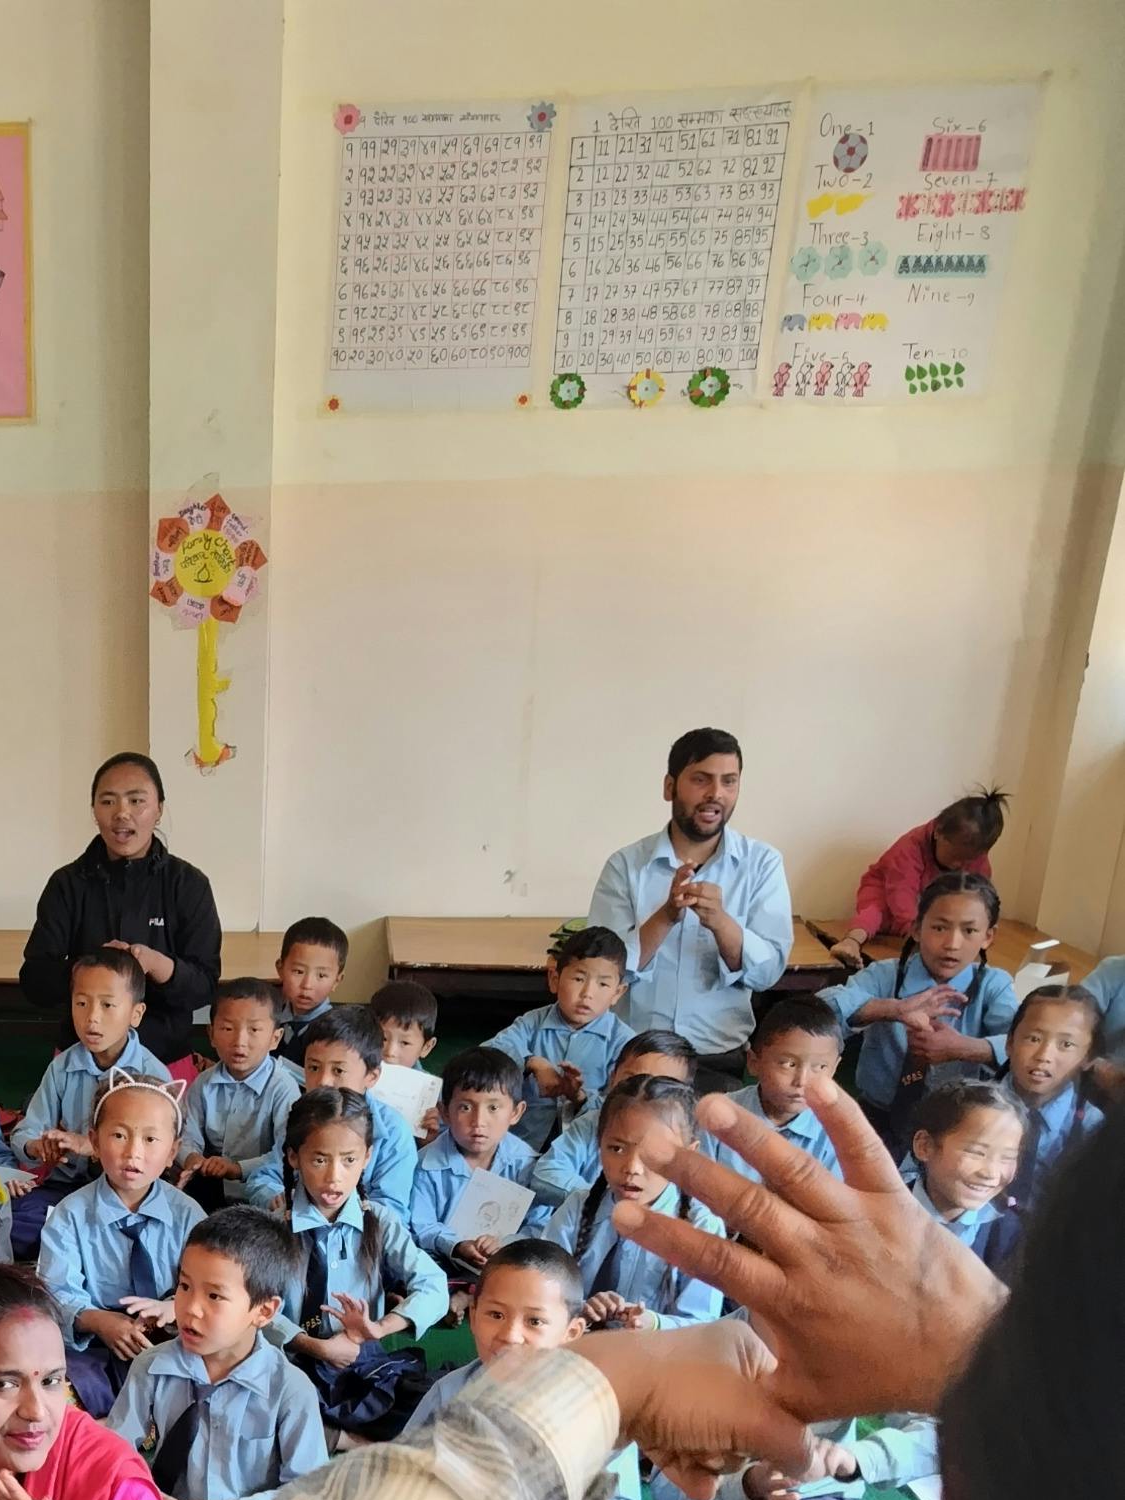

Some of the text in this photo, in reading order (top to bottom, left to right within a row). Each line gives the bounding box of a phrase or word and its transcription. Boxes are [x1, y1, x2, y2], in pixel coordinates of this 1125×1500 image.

[652, 116, 673, 130] 100
[576, 128, 779, 159] 1 11 21 31 41 51 61 71 81 91
[576, 157, 775, 183] 2 12 22 32 42 52 62 72 82 92
[576, 183, 774, 206] 3 13 23 33 43 53 63 73 83 93
[574, 208, 772, 228] 4 14 24 34 44 54 64 74 84 94
[561, 349, 757, 368] 10 20 30 40 50 60 70 80 90 100
